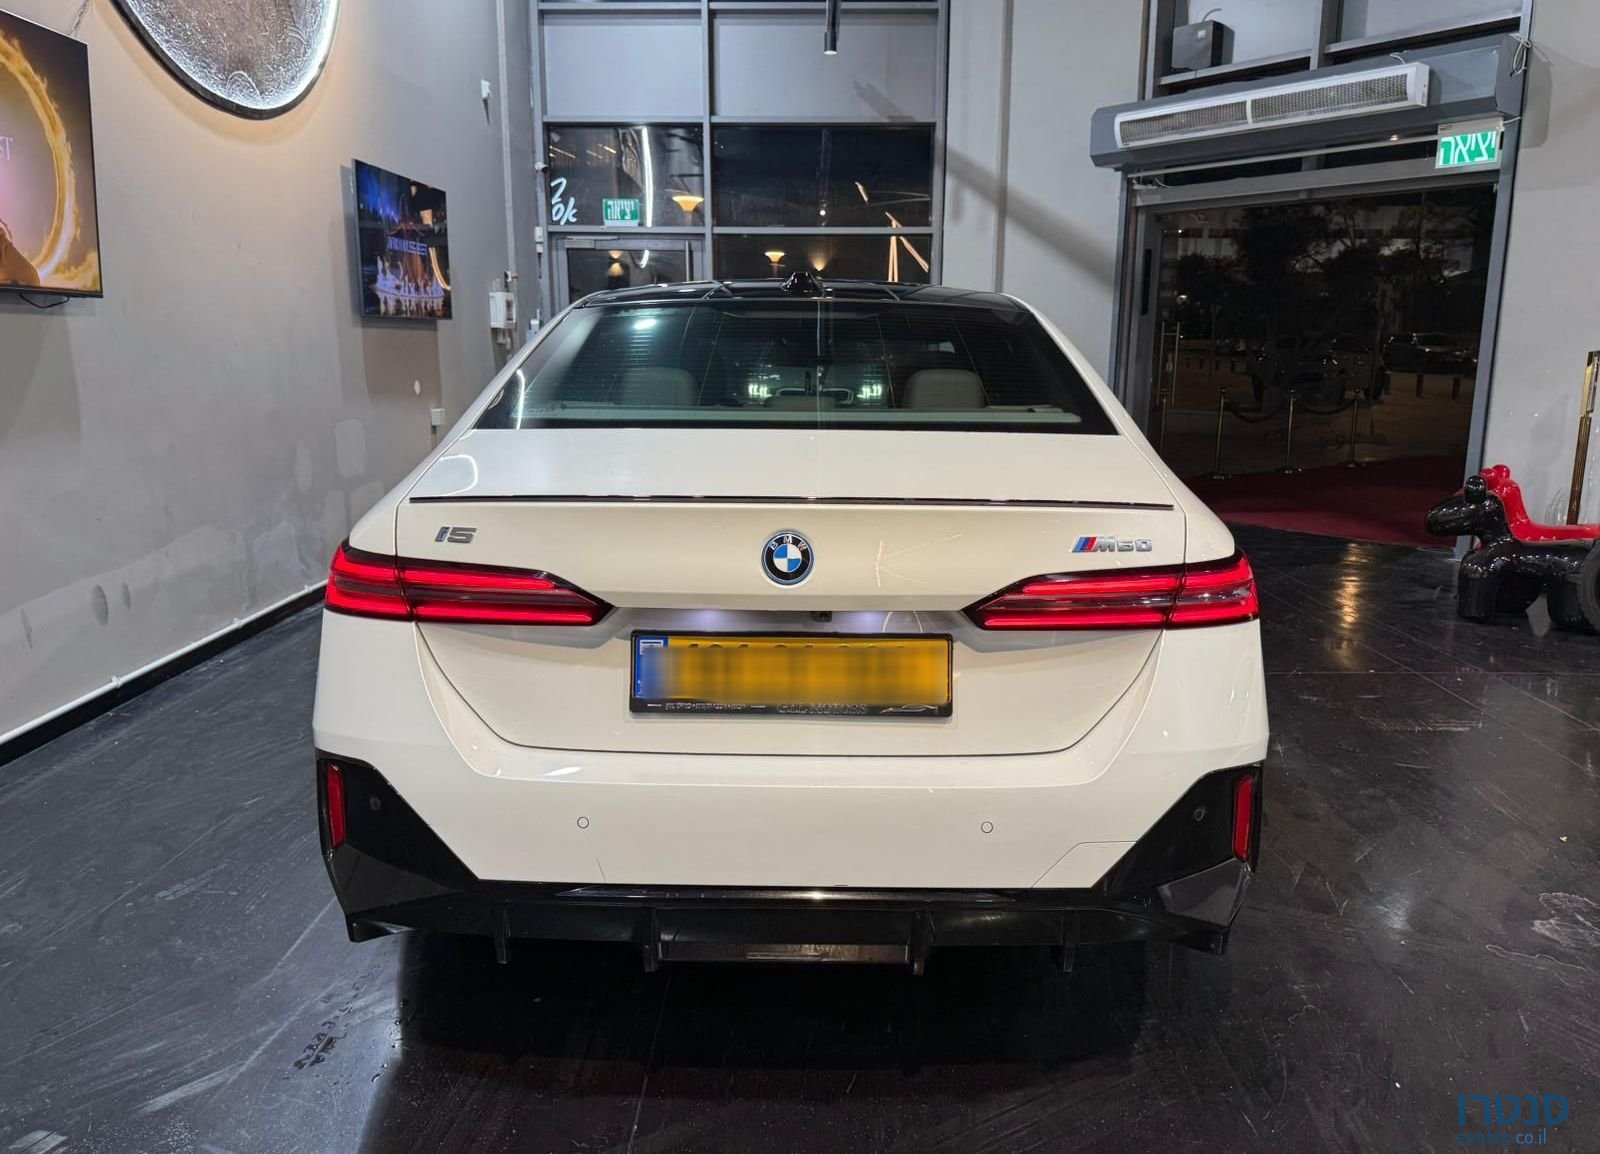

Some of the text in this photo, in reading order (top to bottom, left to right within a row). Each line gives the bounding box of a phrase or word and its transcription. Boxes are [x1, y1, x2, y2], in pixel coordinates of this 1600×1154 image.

[1440, 131, 1497, 165] יציאה
[607, 200, 635, 220] יציאה
[769, 534, 808, 551] BMW
[1094, 535, 1153, 553] M60
